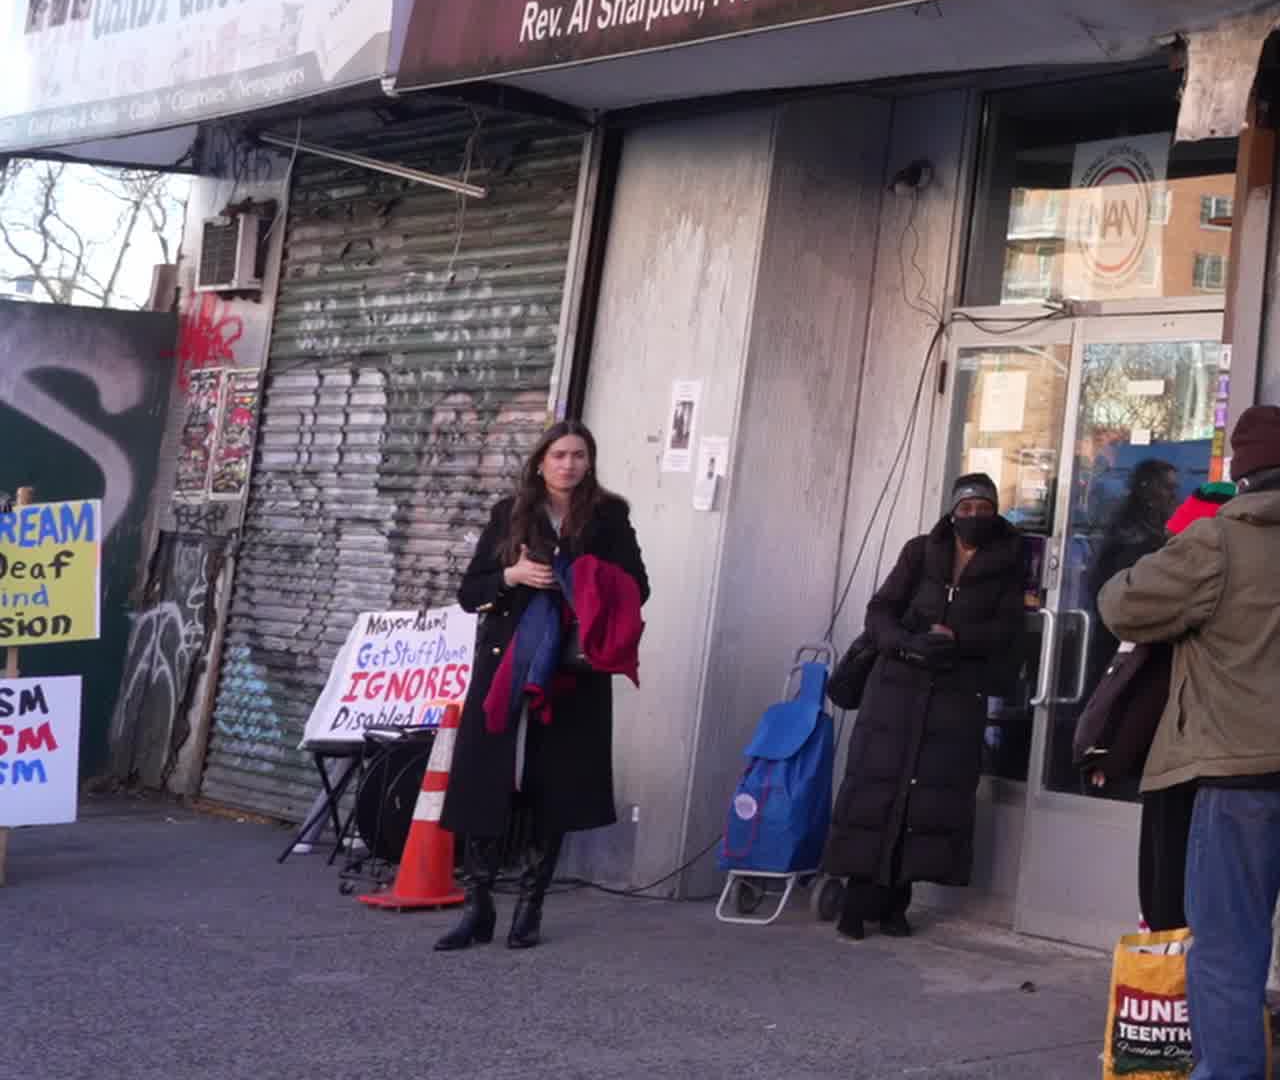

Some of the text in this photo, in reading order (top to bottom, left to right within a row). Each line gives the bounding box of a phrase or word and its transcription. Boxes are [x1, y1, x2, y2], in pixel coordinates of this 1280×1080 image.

[519, 1, 562, 42] Rev.
[340, 663, 470, 703] IGNORES
[330, 705, 415, 733] Disabled
[1119, 995, 1189, 1022] JUNE
[1118, 1021, 1192, 1042] TEENTH
